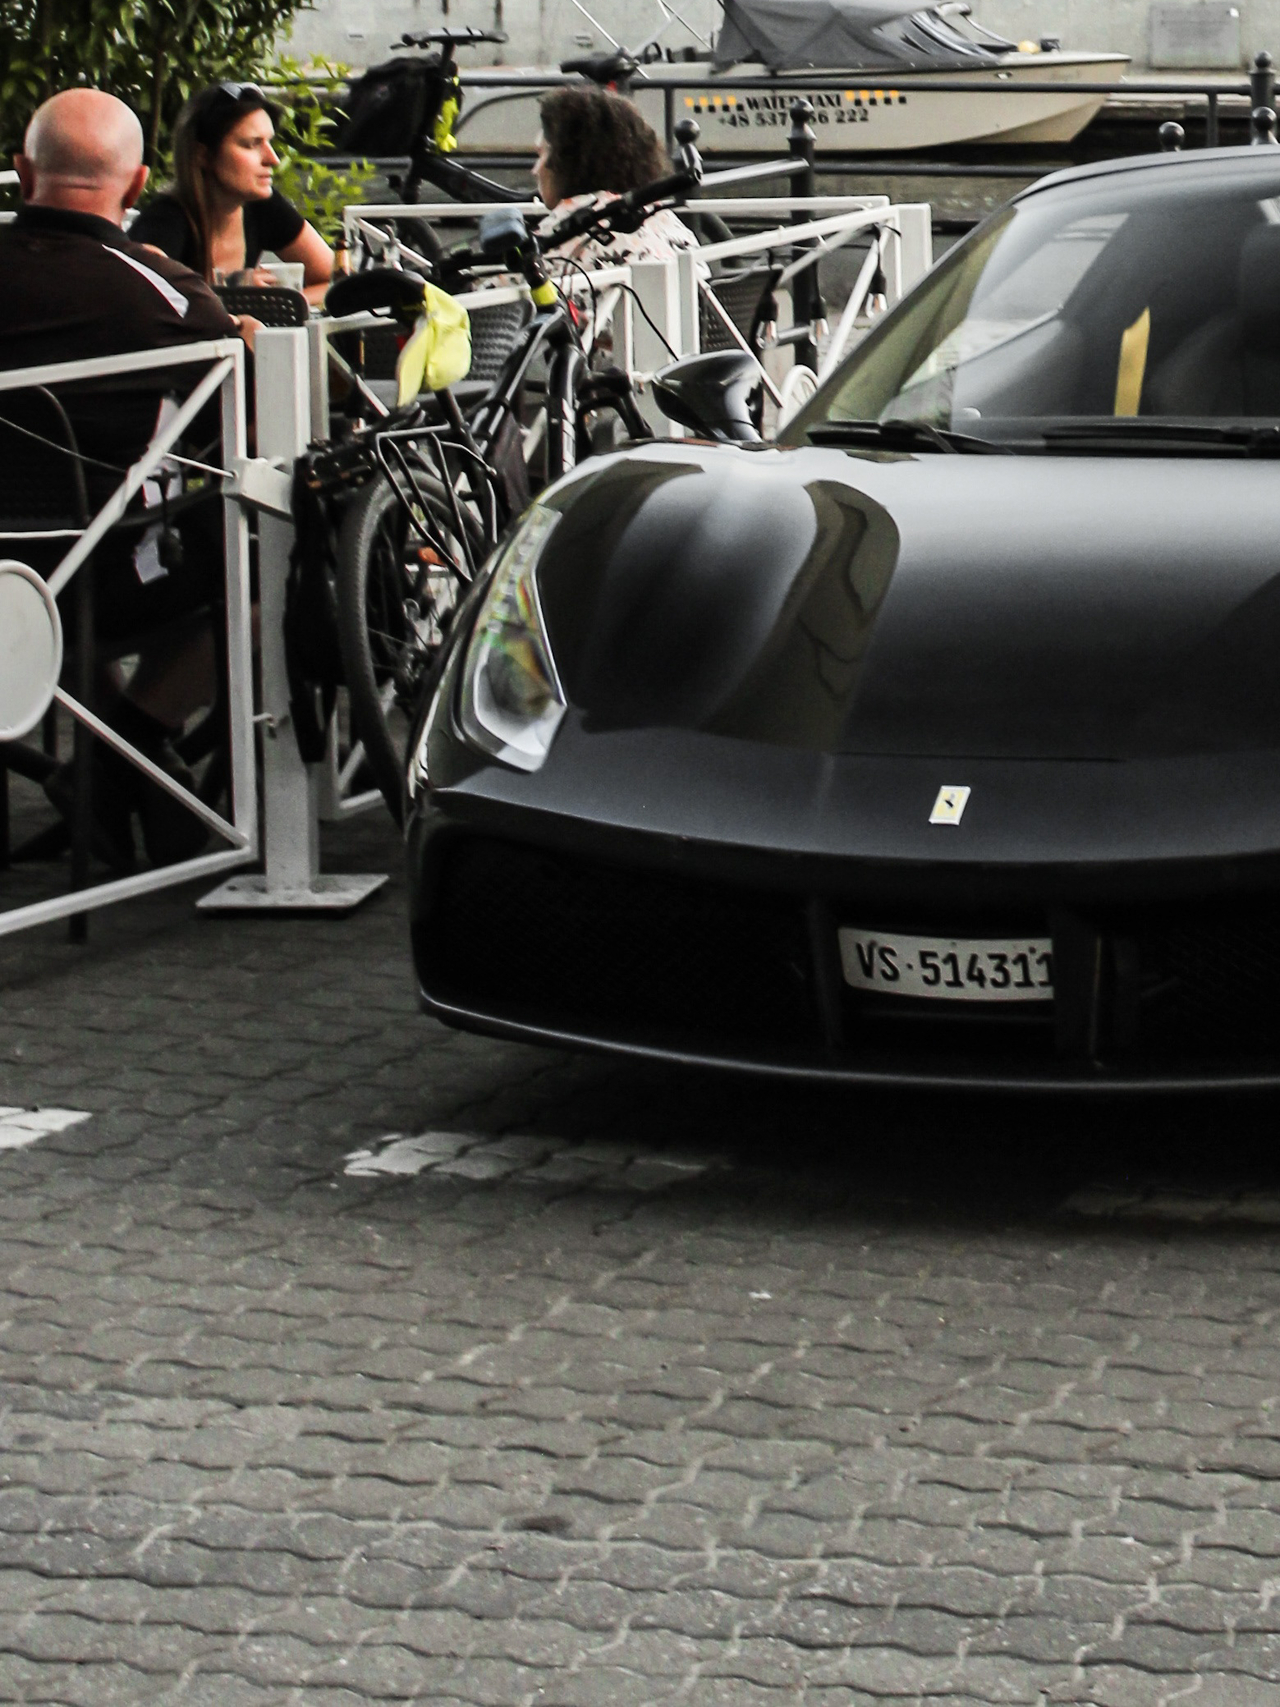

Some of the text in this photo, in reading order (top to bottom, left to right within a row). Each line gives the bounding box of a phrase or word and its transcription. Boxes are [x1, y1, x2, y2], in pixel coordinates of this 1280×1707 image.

[718, 112, 751, 128] +48
[755, 111, 788, 127] 537
[835, 108, 869, 123] 222
